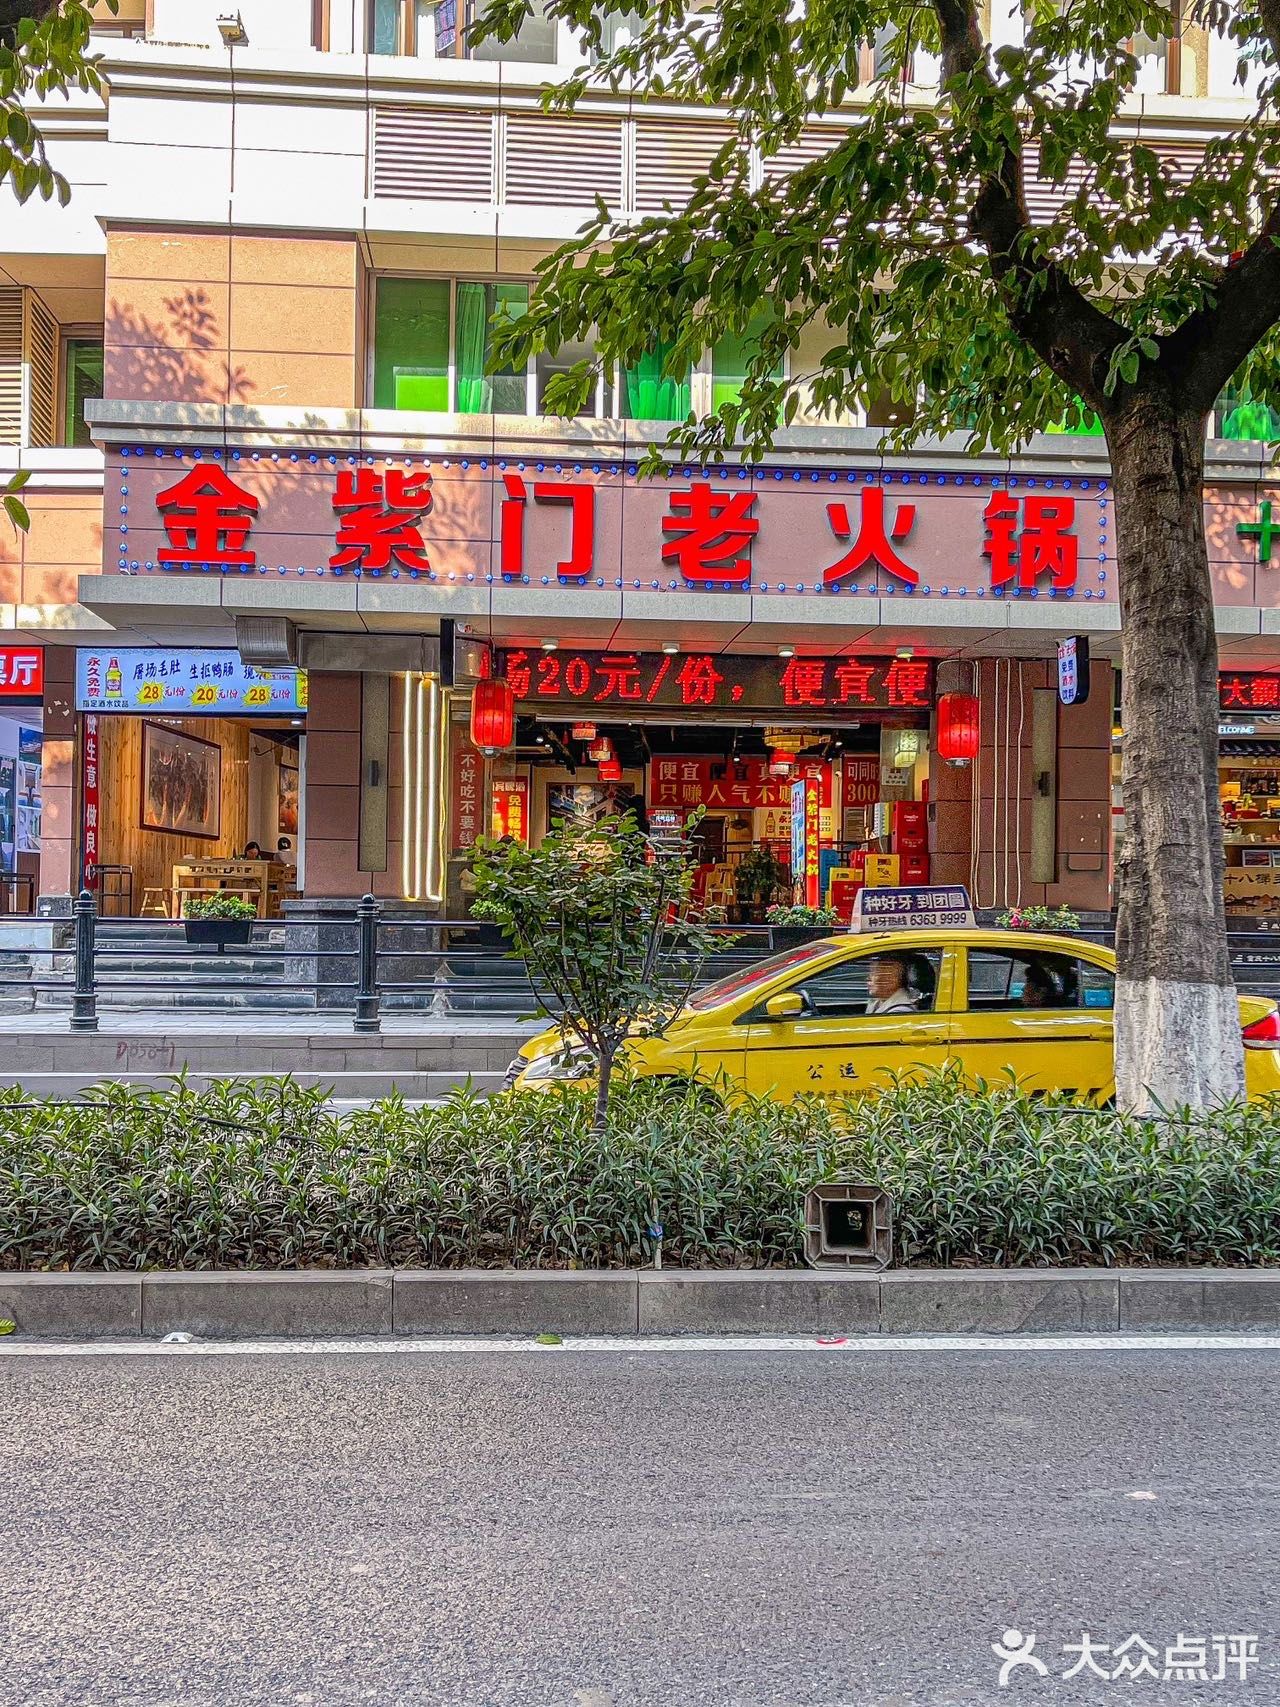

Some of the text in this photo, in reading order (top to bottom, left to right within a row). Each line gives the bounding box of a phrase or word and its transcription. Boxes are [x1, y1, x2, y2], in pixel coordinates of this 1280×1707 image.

[156, 464, 1079, 591] 金紫门老火锅
[0, 655, 38, 686] 厅
[87, 657, 101, 698] 永久免费
[459, 754, 476, 846] 不好吃不要钱
[864, 894, 914, 912] 种好牙
[909, 913, 937, 926] 6363
[940, 912, 967, 925] 9999
[807, 1062, 860, 1080] 公运
